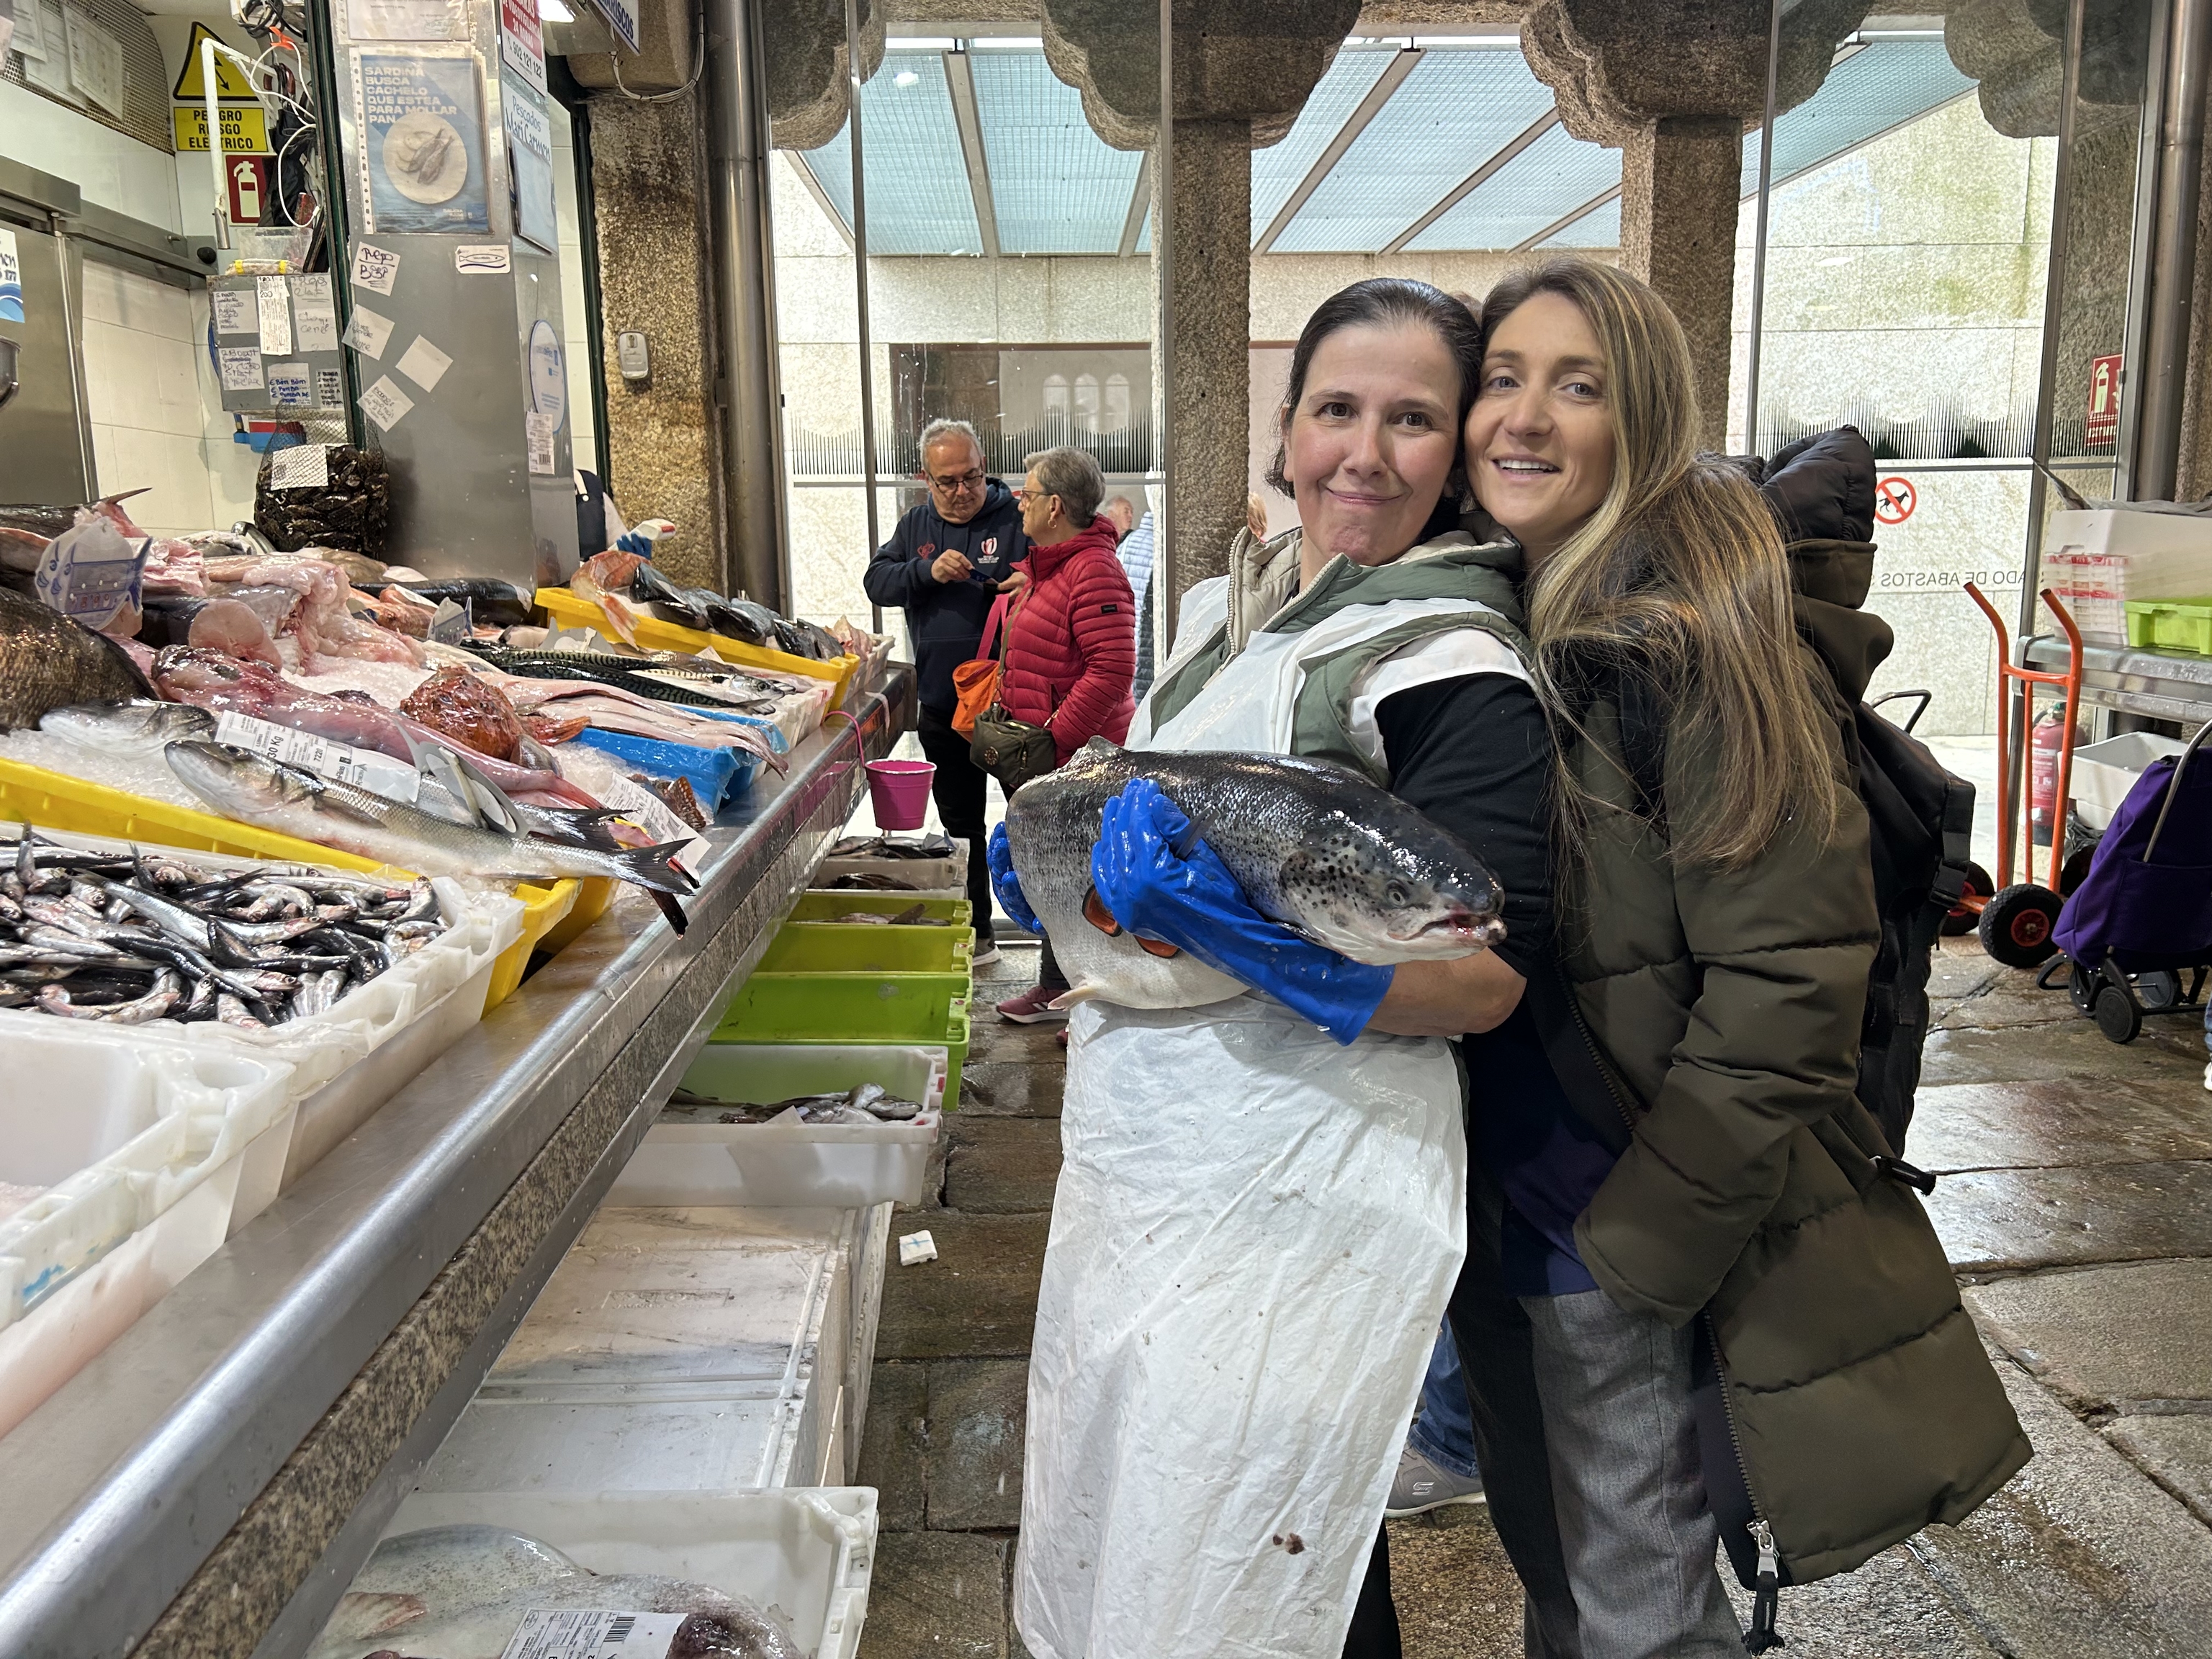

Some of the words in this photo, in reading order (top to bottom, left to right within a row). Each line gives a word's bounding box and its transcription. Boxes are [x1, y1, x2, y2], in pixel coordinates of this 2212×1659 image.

[605, 0, 634, 40] ARISCOS
[513, 17, 519, 36] 24
[519, 23, 534, 49] HORAS
[513, 41, 523, 61] 902
[534, 60, 542, 79] 122
[366, 76, 410, 85] BUSCA
[367, 86, 428, 95] CACHELO
[367, 96, 395, 104] QUE
[397, 96, 441, 105] ESTEA
[193, 109, 242, 121] PEGRO
[368, 105, 403, 114] PARA
[405, 106, 457, 114] MOLLAR
[512, 94, 541, 132] Pescados
[198, 123, 241, 135] RISGO
[189, 135, 253, 149] ELÉTRICO
[271, 735, 284, 747] Kg
